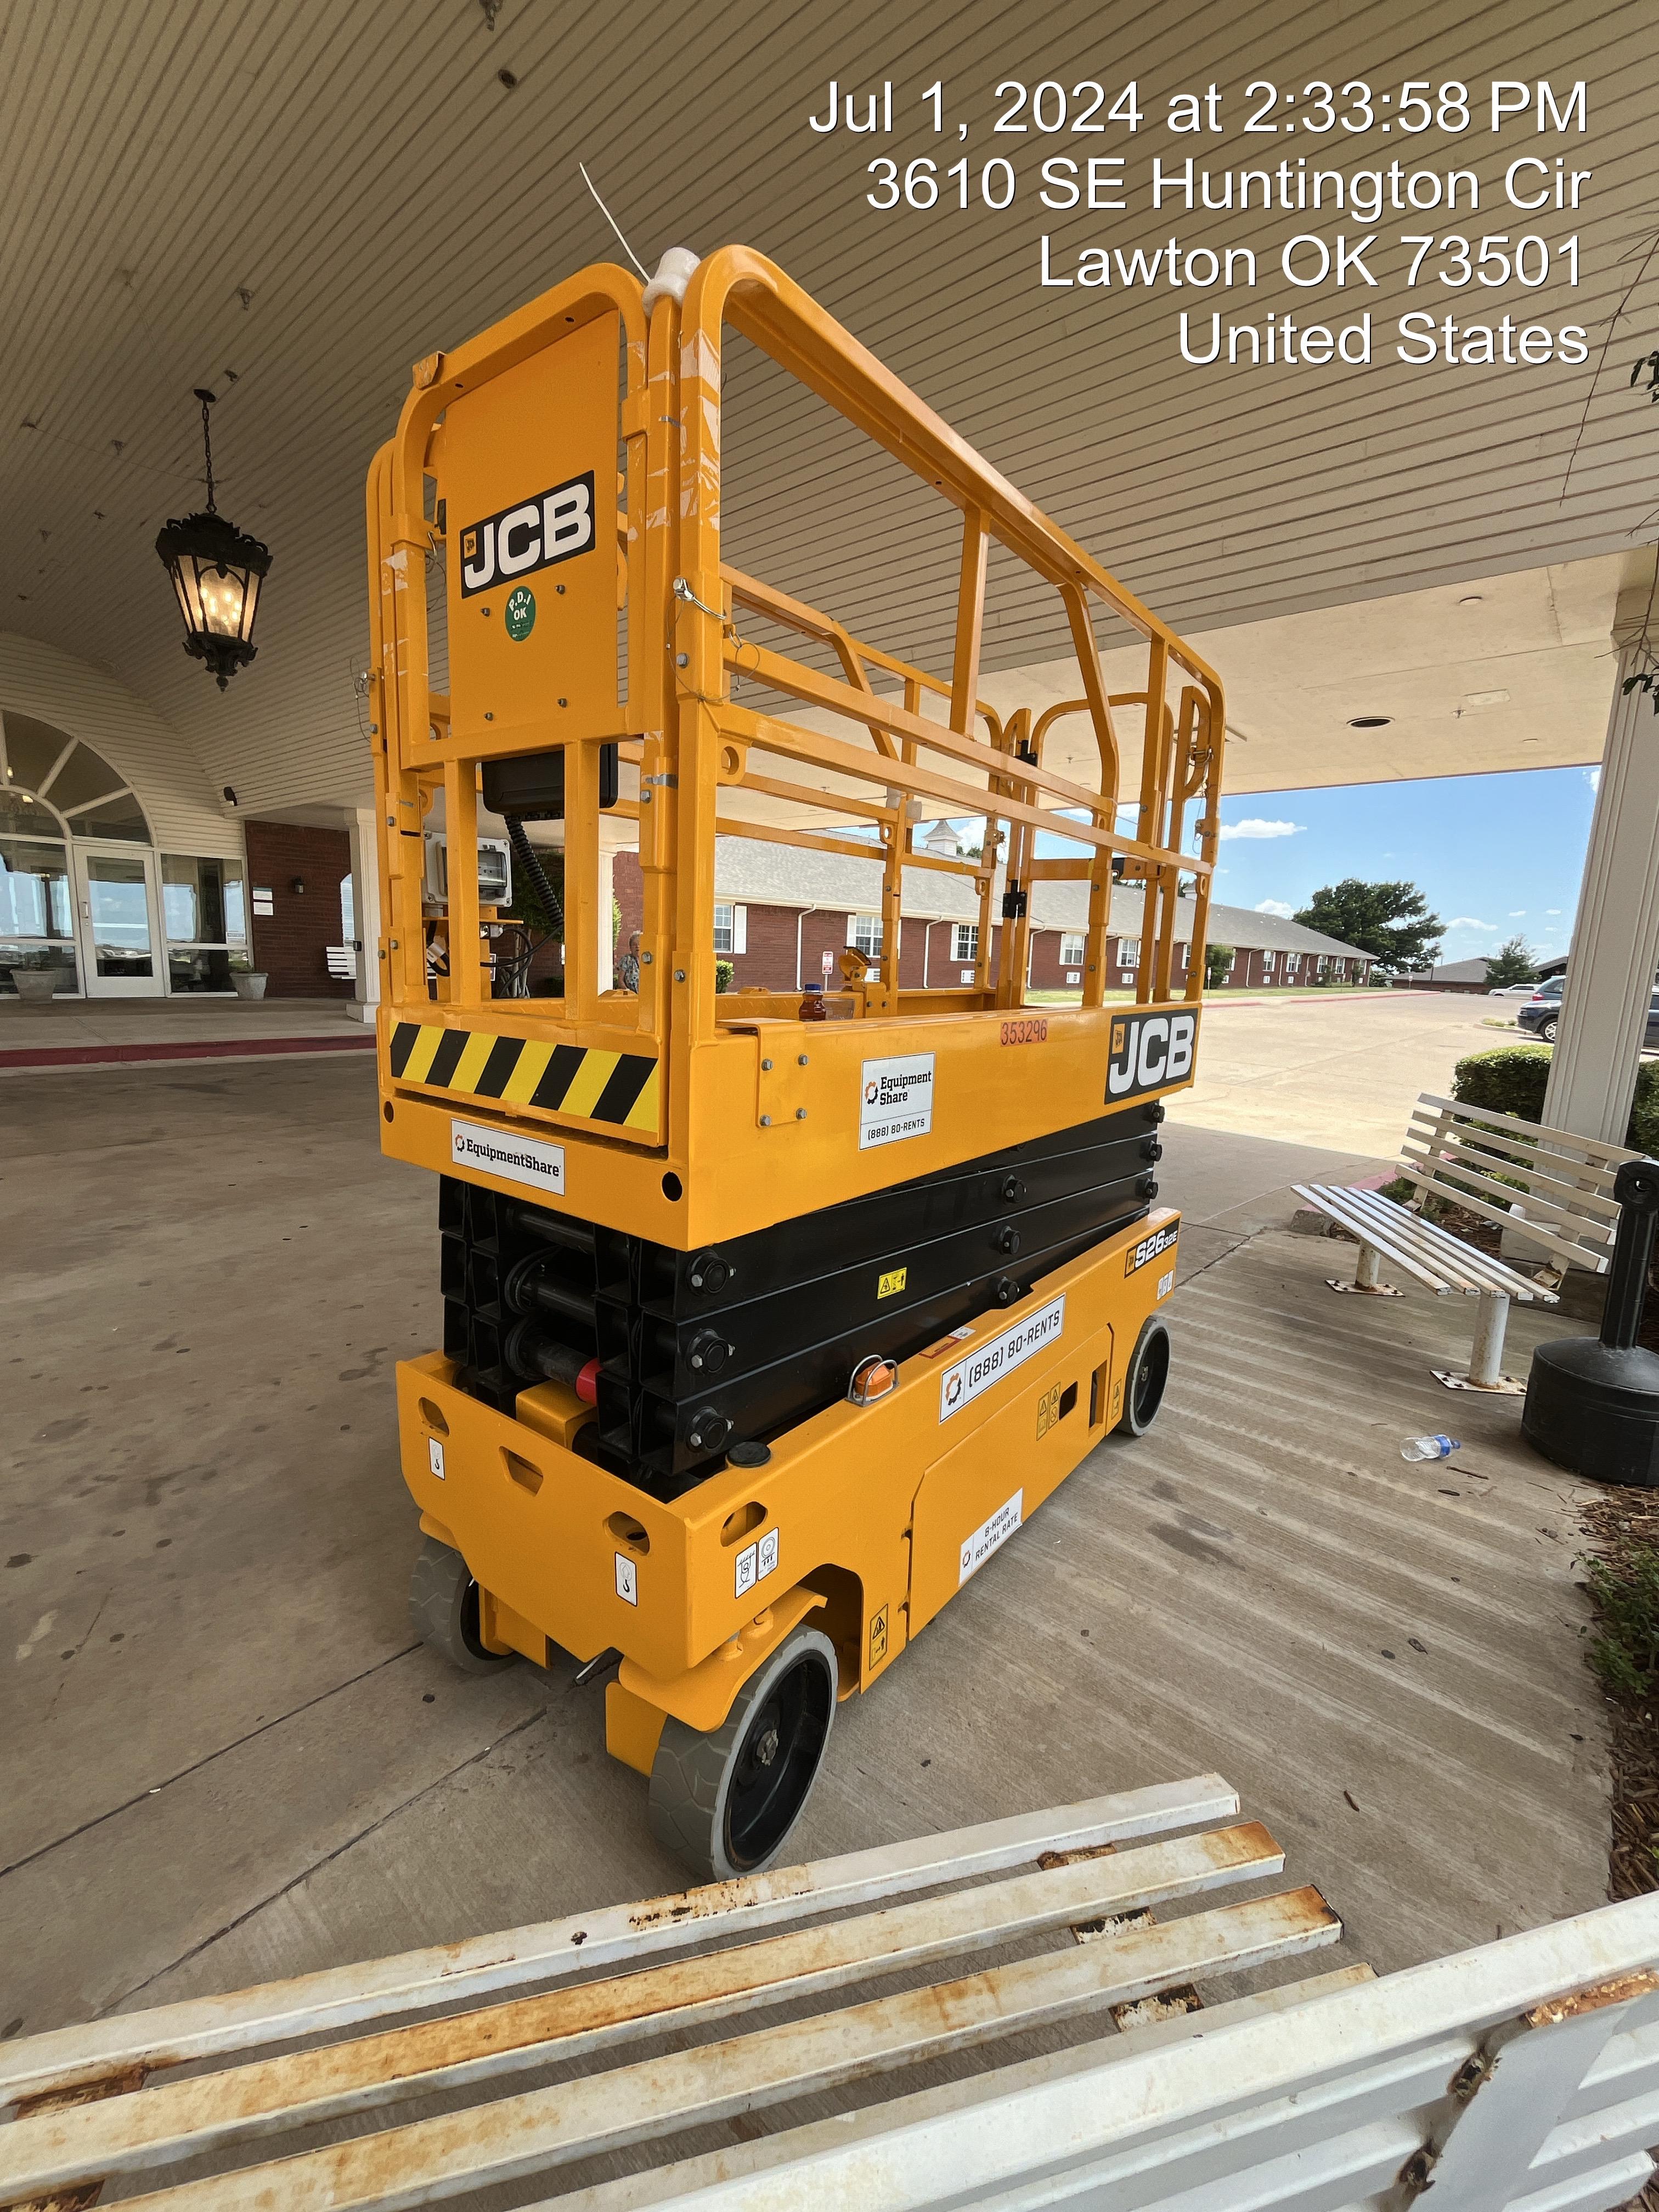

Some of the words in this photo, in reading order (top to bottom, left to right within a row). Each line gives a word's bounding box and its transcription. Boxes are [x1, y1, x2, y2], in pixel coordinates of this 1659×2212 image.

[464, 483, 591, 589] JCB
[514, 606, 527, 620] OK
[1001, 1019, 1047, 1046] 353296
[1109, 1015, 1195, 1094] JCB
[880, 1070, 932, 1091] Equipment
[879, 1091, 909, 1106] Share
[868, 1126, 889, 1141] (888)
[891, 1118, 926, 1135] 80-RENTS
[466, 1138, 560, 1177] EquipmentShare
[968, 1346, 1003, 1388] (888)
[1008, 1310, 1060, 1359] 80-RENTS
[975, 1530, 1000, 1561] RENTAL
[1002, 1511, 1019, 1535] RATE
[984, 1507, 1009, 1538] 8-HOUR
